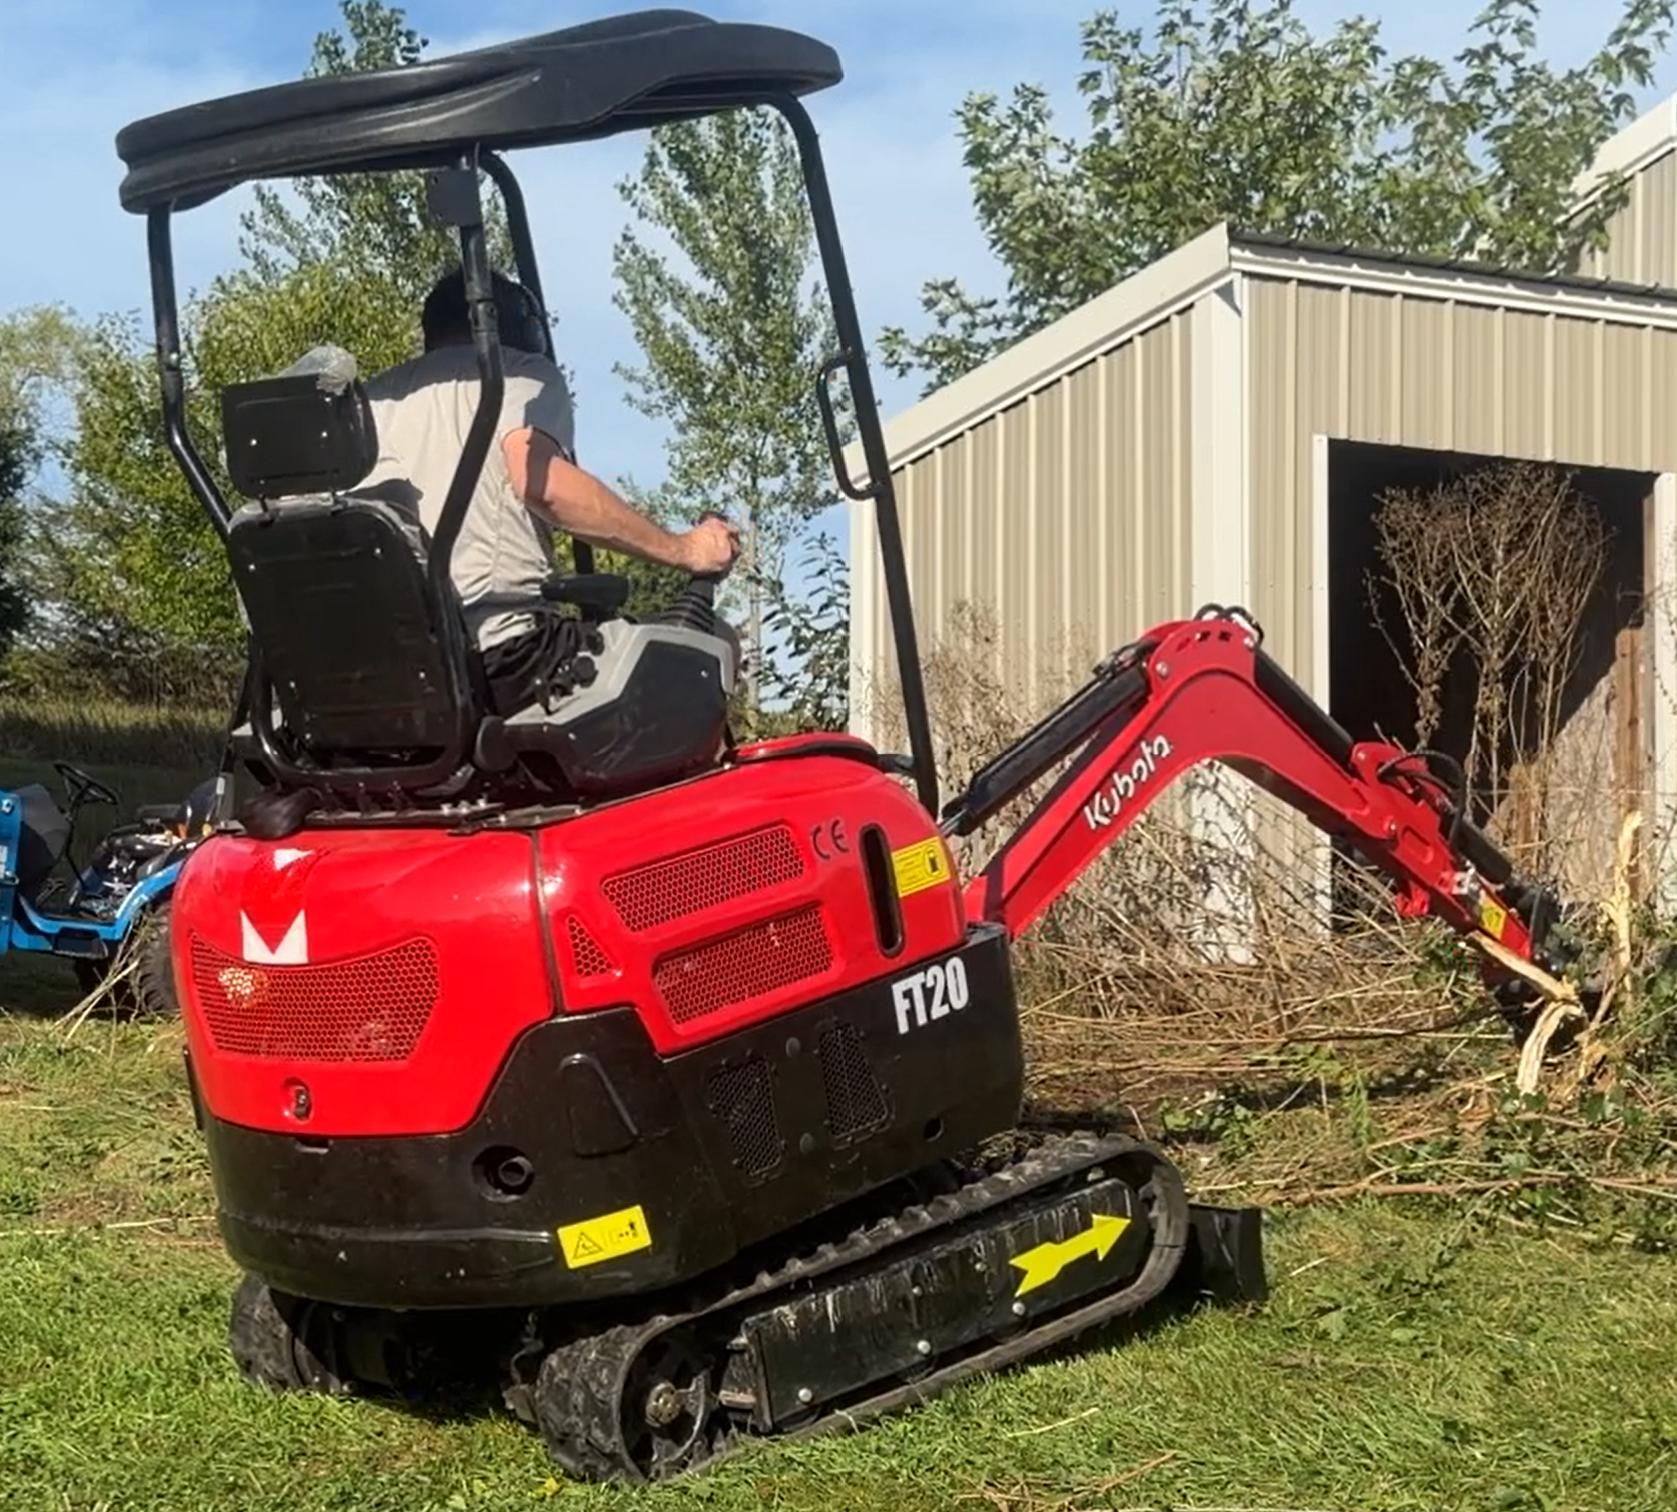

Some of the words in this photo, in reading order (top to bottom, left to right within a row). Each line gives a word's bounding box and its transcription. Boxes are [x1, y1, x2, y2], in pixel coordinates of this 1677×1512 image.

[1084, 735, 1170, 830] Kubota
[812, 819, 850, 861] CE
[891, 956, 970, 1035] FT20
